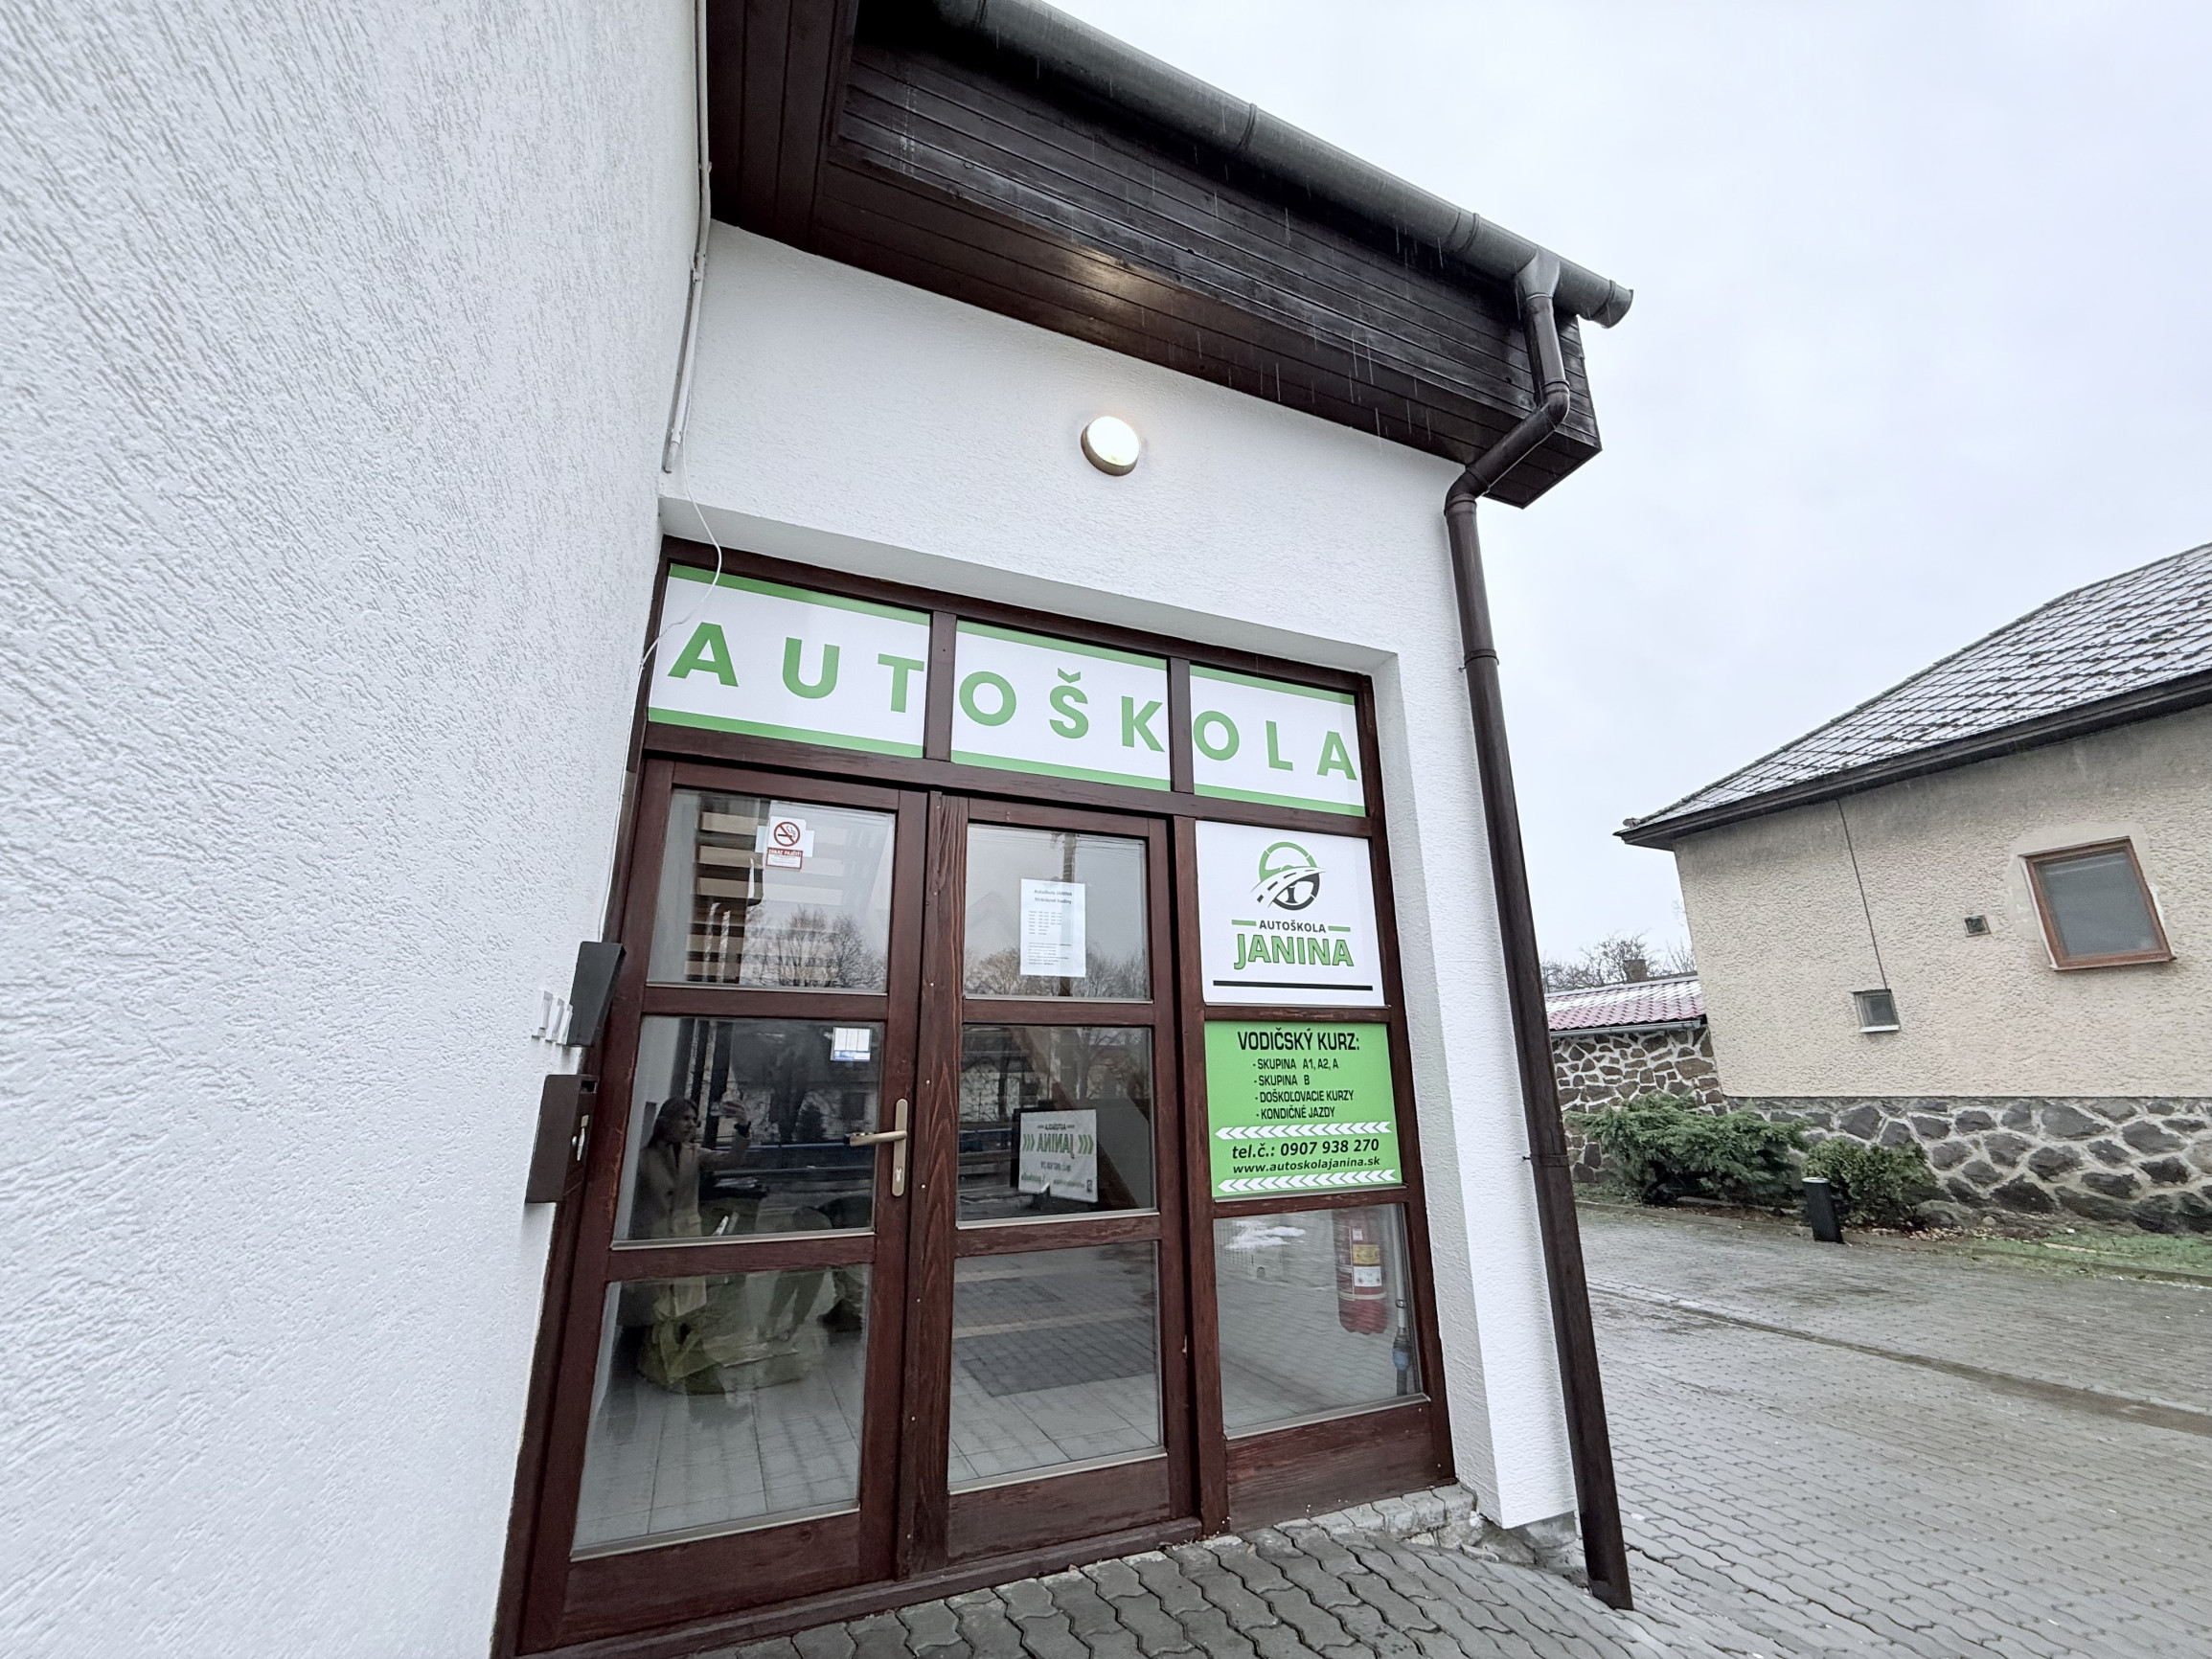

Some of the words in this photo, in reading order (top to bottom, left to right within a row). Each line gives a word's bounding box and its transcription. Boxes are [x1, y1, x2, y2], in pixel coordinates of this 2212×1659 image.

[668, 622, 1357, 781] AUTOŠKOLA
[1259, 920, 1327, 933] AUTOŠKOLA
[1234, 933, 1355, 970] JANINA
[1237, 1028, 1313, 1051] VODIČSKÝ
[1317, 1033, 1360, 1051] KURZ:
[1257, 1058, 1297, 1070] SKUPINA
[1303, 1059, 1316, 1070] A1,
[1317, 1059, 1333, 1070] A2,
[1333, 1059, 1339, 1069] A
[1258, 1075, 1298, 1086] SKUPINA
[1304, 1075, 1311, 1085] B
[1260, 1089, 1325, 1102] DOŠKOLOVACIE
[1326, 1090, 1354, 1102] KURZY
[1261, 1104, 1307, 1120] KONDIČNÉ
[1309, 1106, 1335, 1118] JAZDY
[1232, 1142, 1275, 1159] tel.č.:
[1280, 1142, 1318, 1157] 0907
[1322, 1140, 1349, 1154] 938
[1354, 1138, 1380, 1152] 270
[1233, 1156, 1380, 1173] www.autoskolajanina.sk
